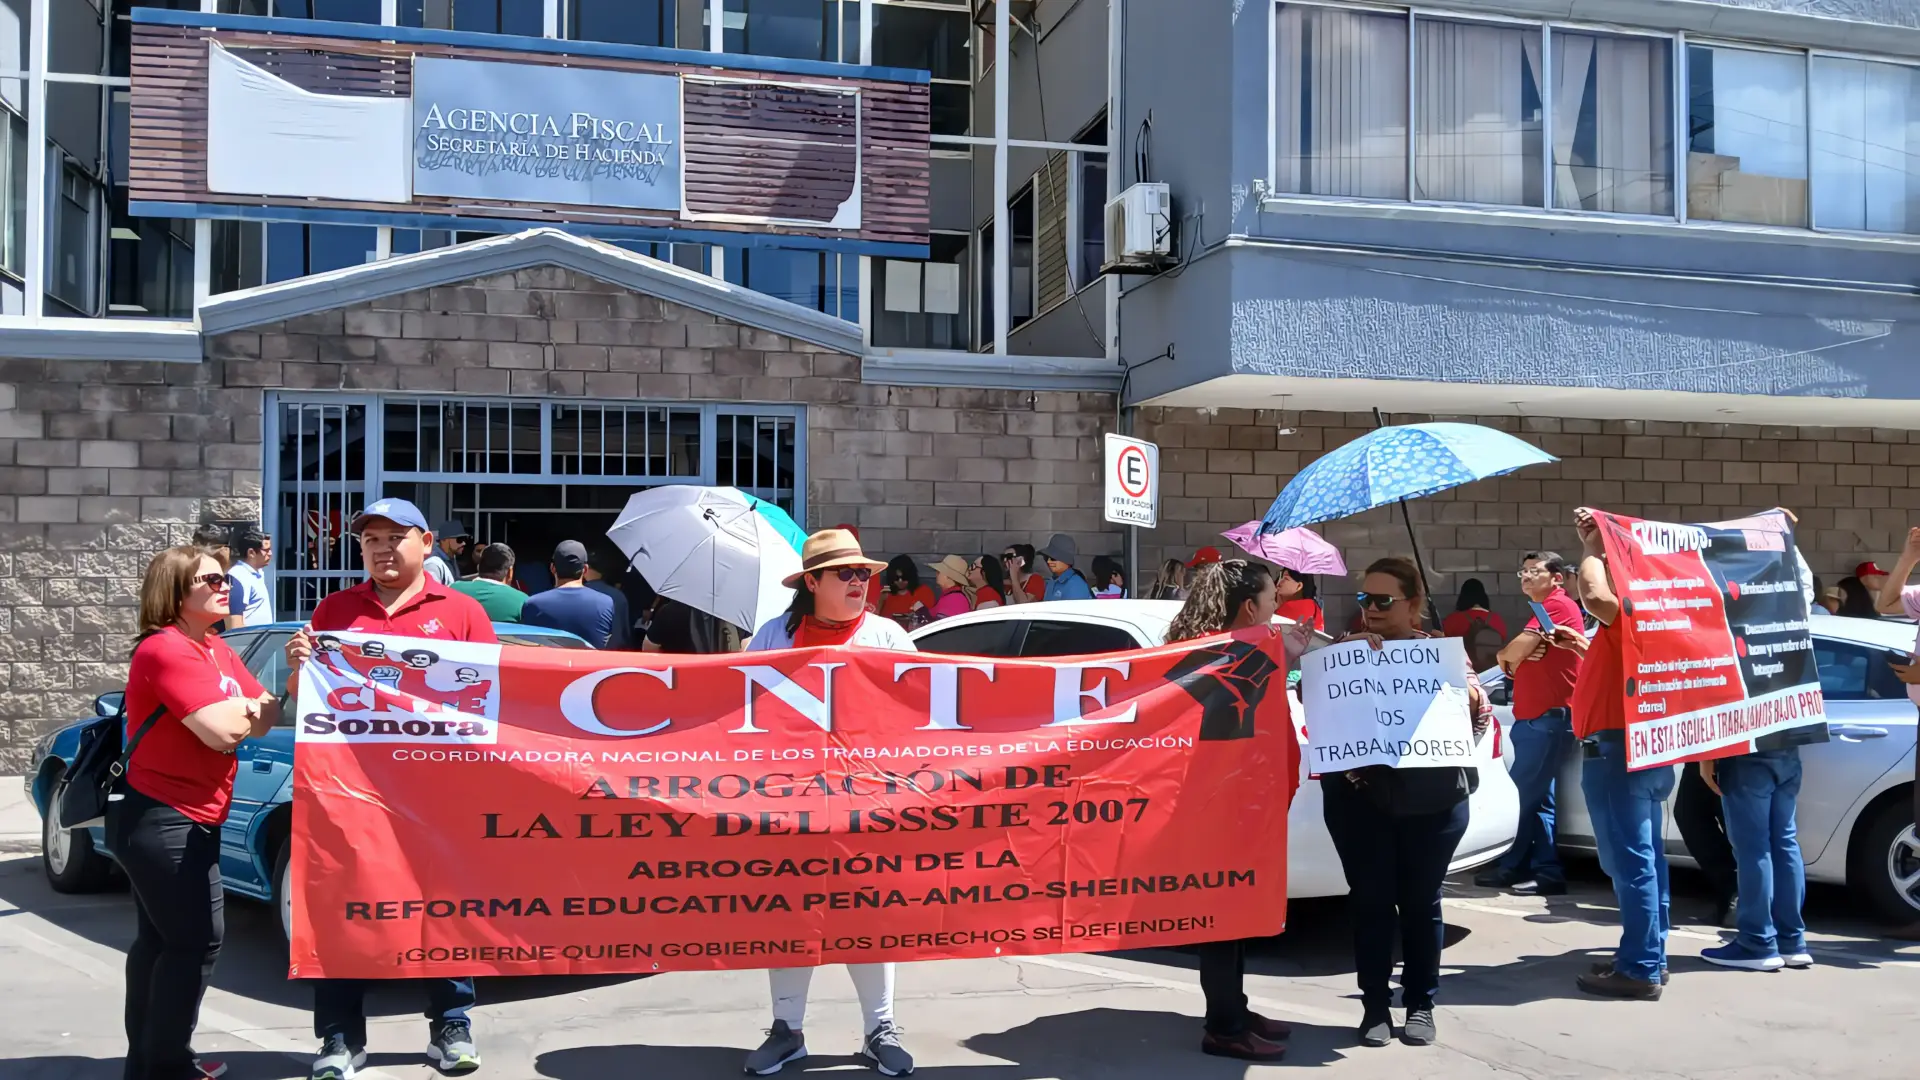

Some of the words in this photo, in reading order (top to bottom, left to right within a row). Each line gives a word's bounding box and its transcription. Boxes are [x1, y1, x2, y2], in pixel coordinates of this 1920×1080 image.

[421, 103, 560, 137] AGENCIA
[569, 112, 673, 145] FISCAL
[427, 134, 540, 157] SECRETARÍA
[545, 143, 569, 160] DE
[575, 143, 665, 166] HACIENDA
[1127, 456, 1142, 485] E
[559, 661, 1138, 737] CNTE
[1327, 678, 1387, 700] DIGNA
[1393, 678, 1443, 695] PARA
[303, 713, 489, 737] Sonora
[1375, 707, 1405, 727] LOS
[1651, 724, 1675, 756] ESTA
[1676, 714, 1716, 748] ESCUELA
[1717, 701, 1773, 740] TRABAJAMOS
[1774, 694, 1797, 724] BAJO
[392, 749, 594, 764] COORDINADORA
[602, 749, 727, 763] NACIONAL
[734, 748, 765, 762] DE
[771, 747, 815, 761] LOS
[824, 743, 993, 760] TRABAJADORES
[999, 741, 1027, 755] DE
[1035, 740, 1061, 753] LA
[1066, 735, 1194, 752] EDUCACIÓN
[578, 763, 985, 800] ABROGACIÓN
[1004, 763, 1072, 789] DE
[481, 813, 563, 839] LA
[574, 812, 705, 839] LEY
[712, 810, 830, 838] DEL
[849, 801, 1029, 835] ISSSTE
[1047, 797, 1150, 826] 2007
[627, 851, 902, 880] ABROGACIÓN
[914, 851, 964, 872] DE
[976, 850, 1020, 869] LA
[345, 897, 552, 921] REFORMA
[562, 892, 792, 917] EDUCATIVA
[804, 869, 1256, 912] PEÑA-AMLO-SHEINBAUM
[562, 942, 653, 960] QUIEN
[822, 935, 873, 952] LOS
[880, 928, 1027, 949] DERECHOS
[1032, 926, 1063, 940] SE
[1070, 915, 1215, 939] DEFIENDEN!
